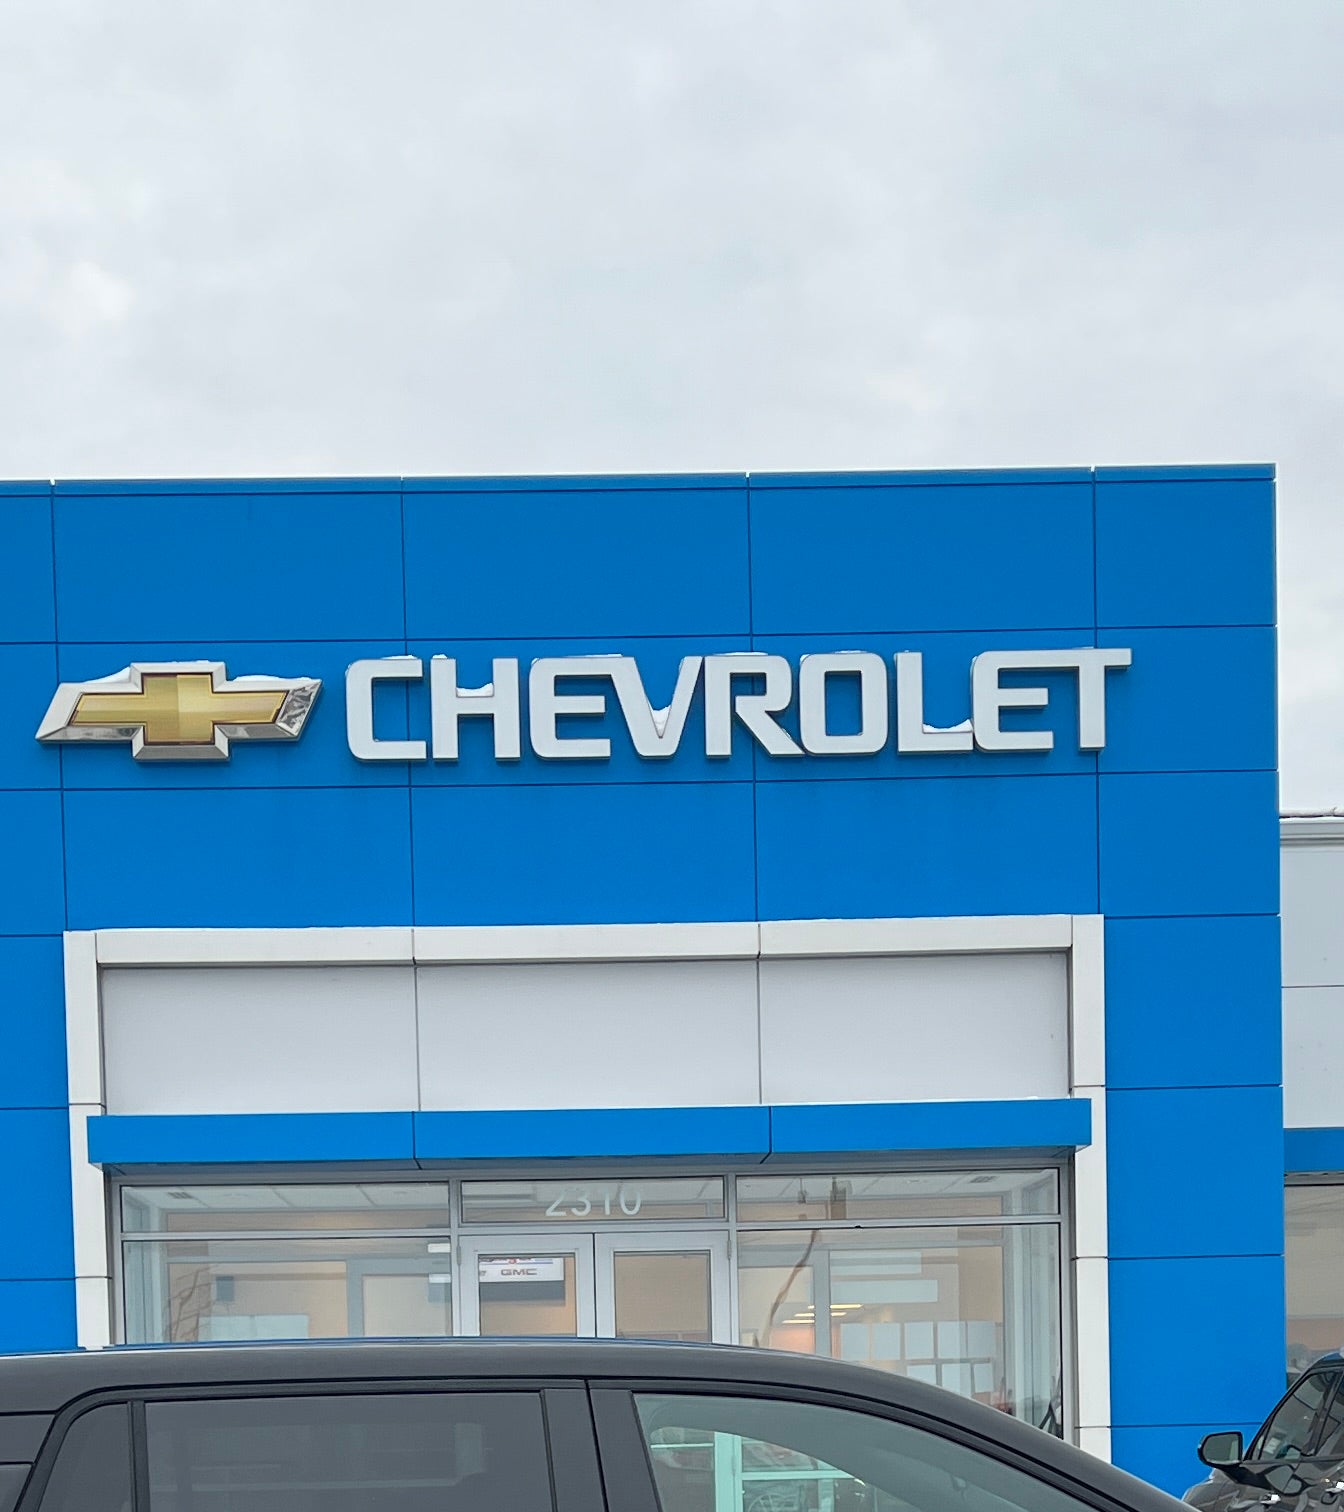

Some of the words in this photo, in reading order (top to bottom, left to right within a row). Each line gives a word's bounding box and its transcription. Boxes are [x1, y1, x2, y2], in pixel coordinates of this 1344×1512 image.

[345, 648, 1133, 760] CHEVROLET
[545, 1182, 642, 1217] 2310
[500, 1268, 538, 1276] GMC
